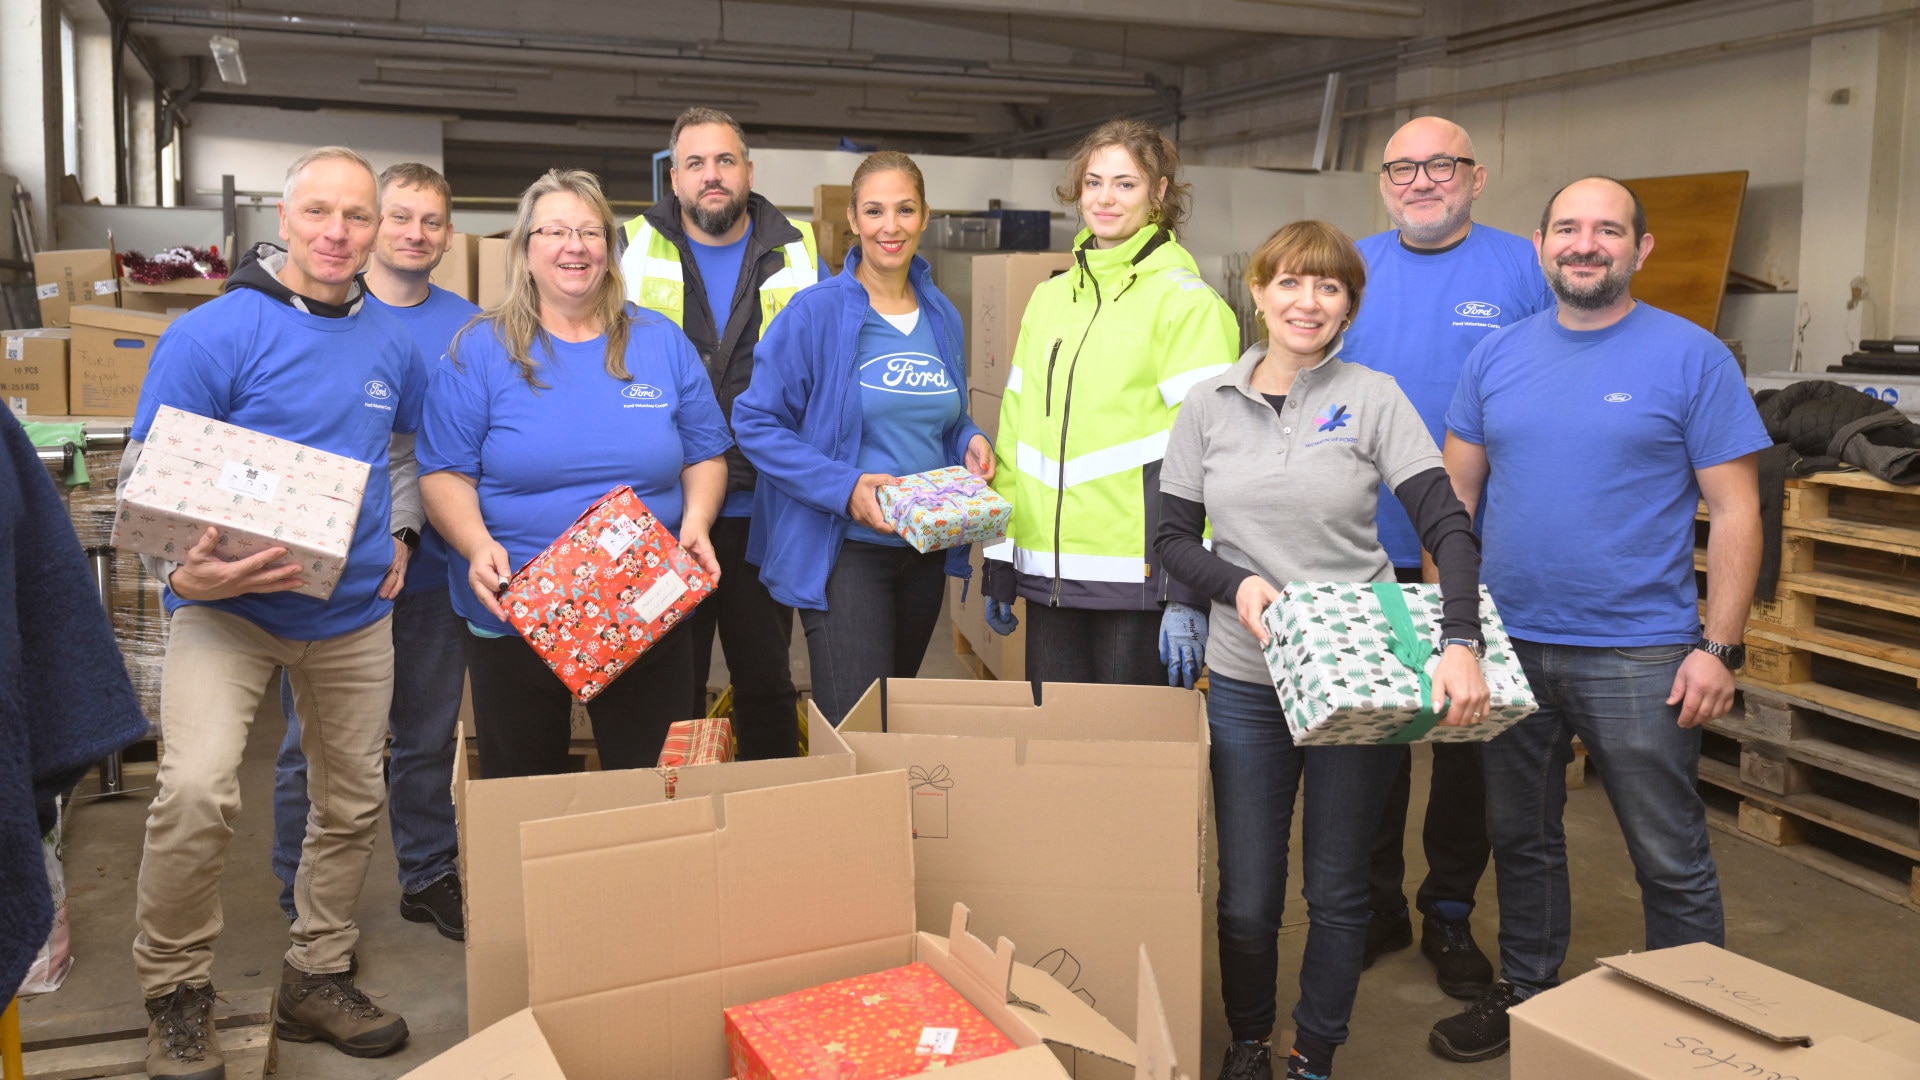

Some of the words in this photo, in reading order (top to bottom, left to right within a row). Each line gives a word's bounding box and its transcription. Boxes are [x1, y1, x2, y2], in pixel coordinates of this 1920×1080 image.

[1462, 303, 1493, 316] Ford
[14, 367, 22, 375] 10
[24, 366, 39, 375] PCS
[882, 358, 949, 387] Ford
[25, 382, 40, 391] KGS
[370, 382, 387, 397] Ford
[629, 385, 655, 398] Ford
[1189, 617, 1199, 641] HyFlex
